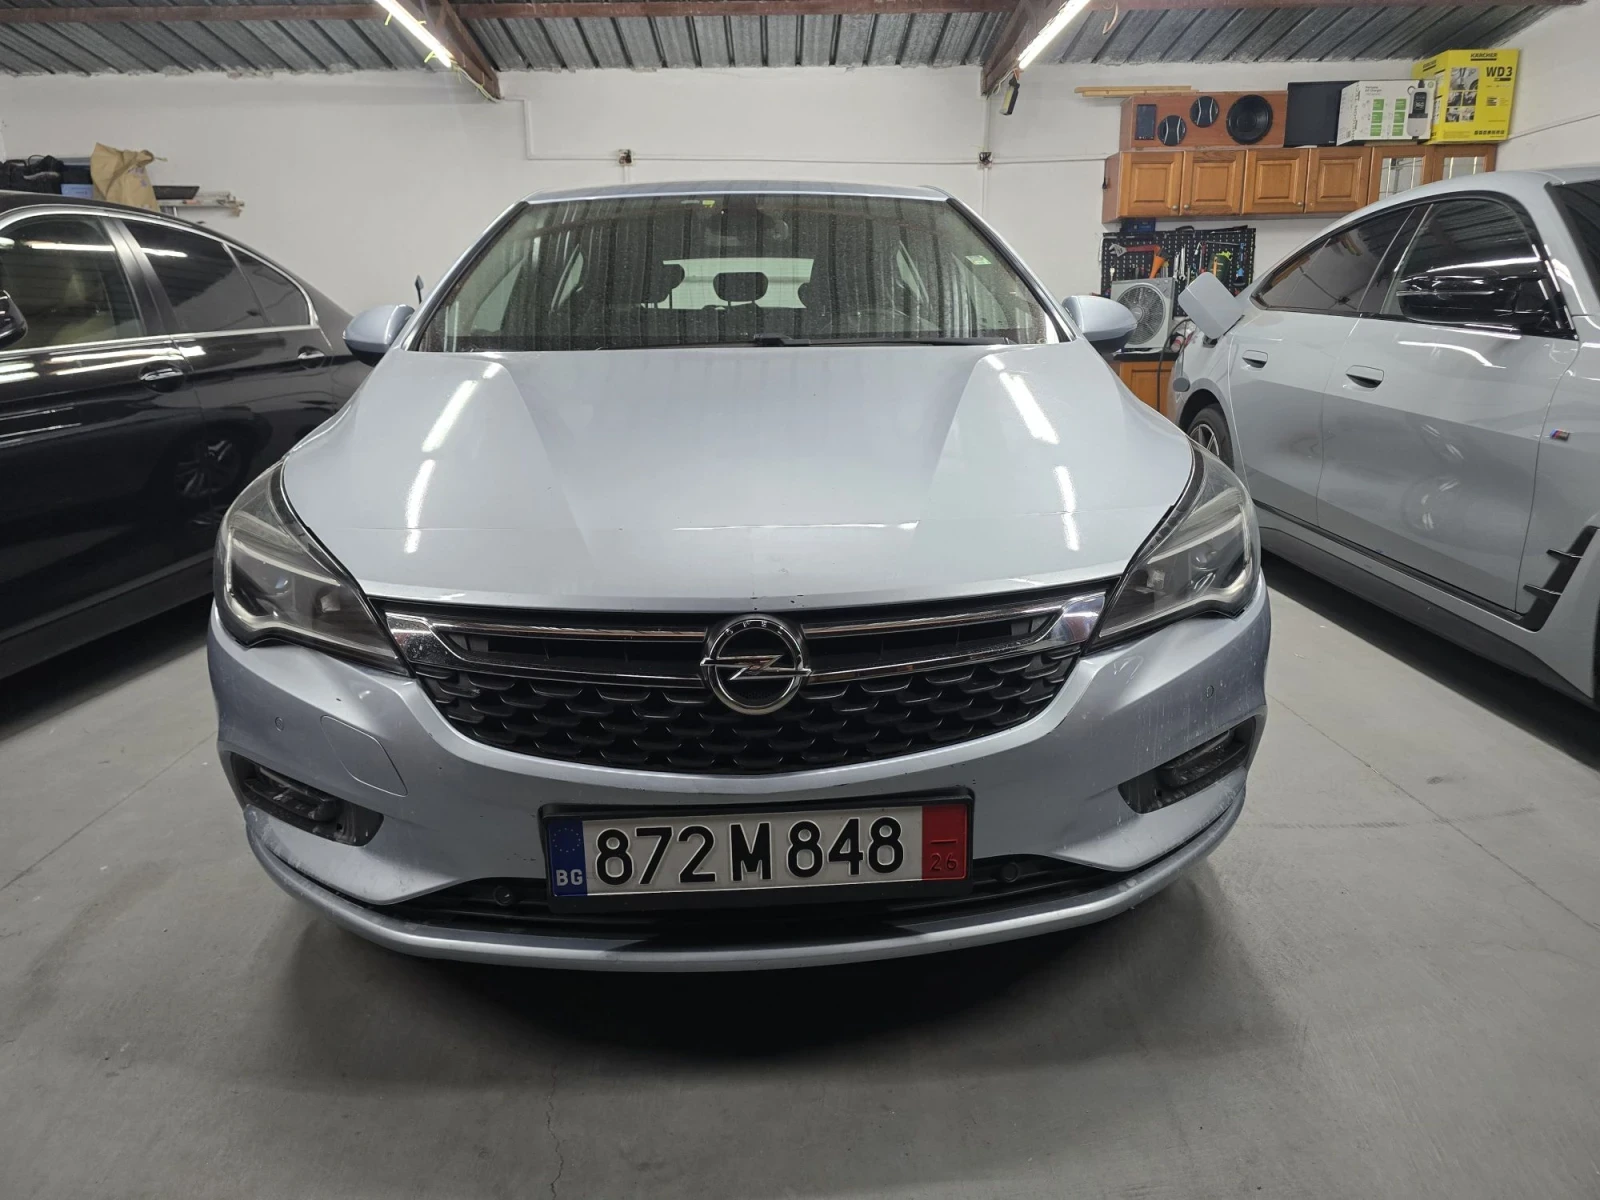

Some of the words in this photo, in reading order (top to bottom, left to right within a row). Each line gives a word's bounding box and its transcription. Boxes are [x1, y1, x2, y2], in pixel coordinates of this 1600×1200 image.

[1486, 66, 1505, 77] WD
[1507, 66, 1513, 77] 3
[929, 851, 958, 872] 26
[555, 869, 584, 887] BG
